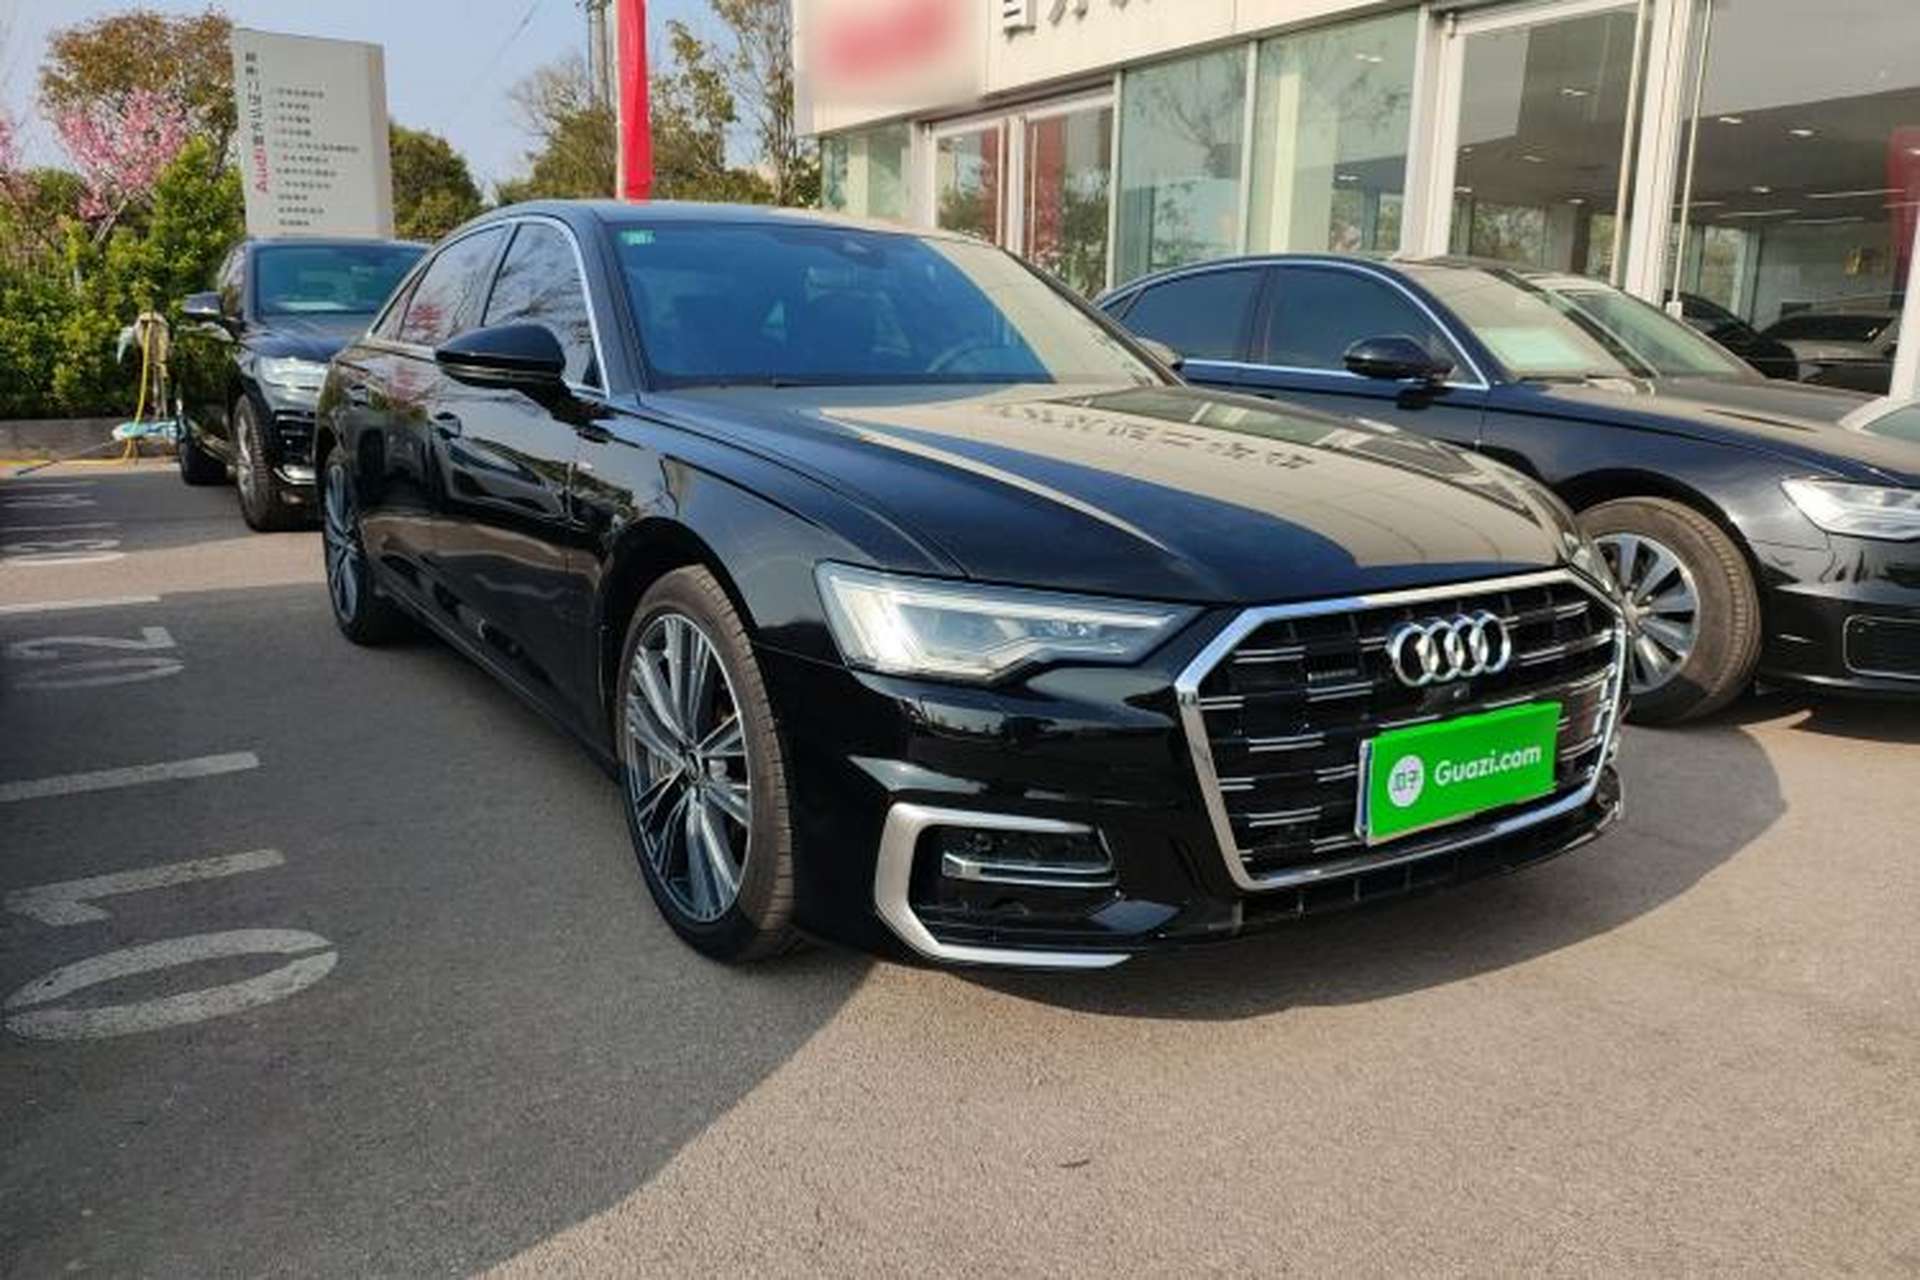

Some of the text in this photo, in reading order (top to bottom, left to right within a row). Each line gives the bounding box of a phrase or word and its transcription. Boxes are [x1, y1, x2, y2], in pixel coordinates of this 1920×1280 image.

[10, 626, 184, 688] 02
[1435, 746, 1542, 787] Guazi.com
[2, 848, 339, 1041] 01
